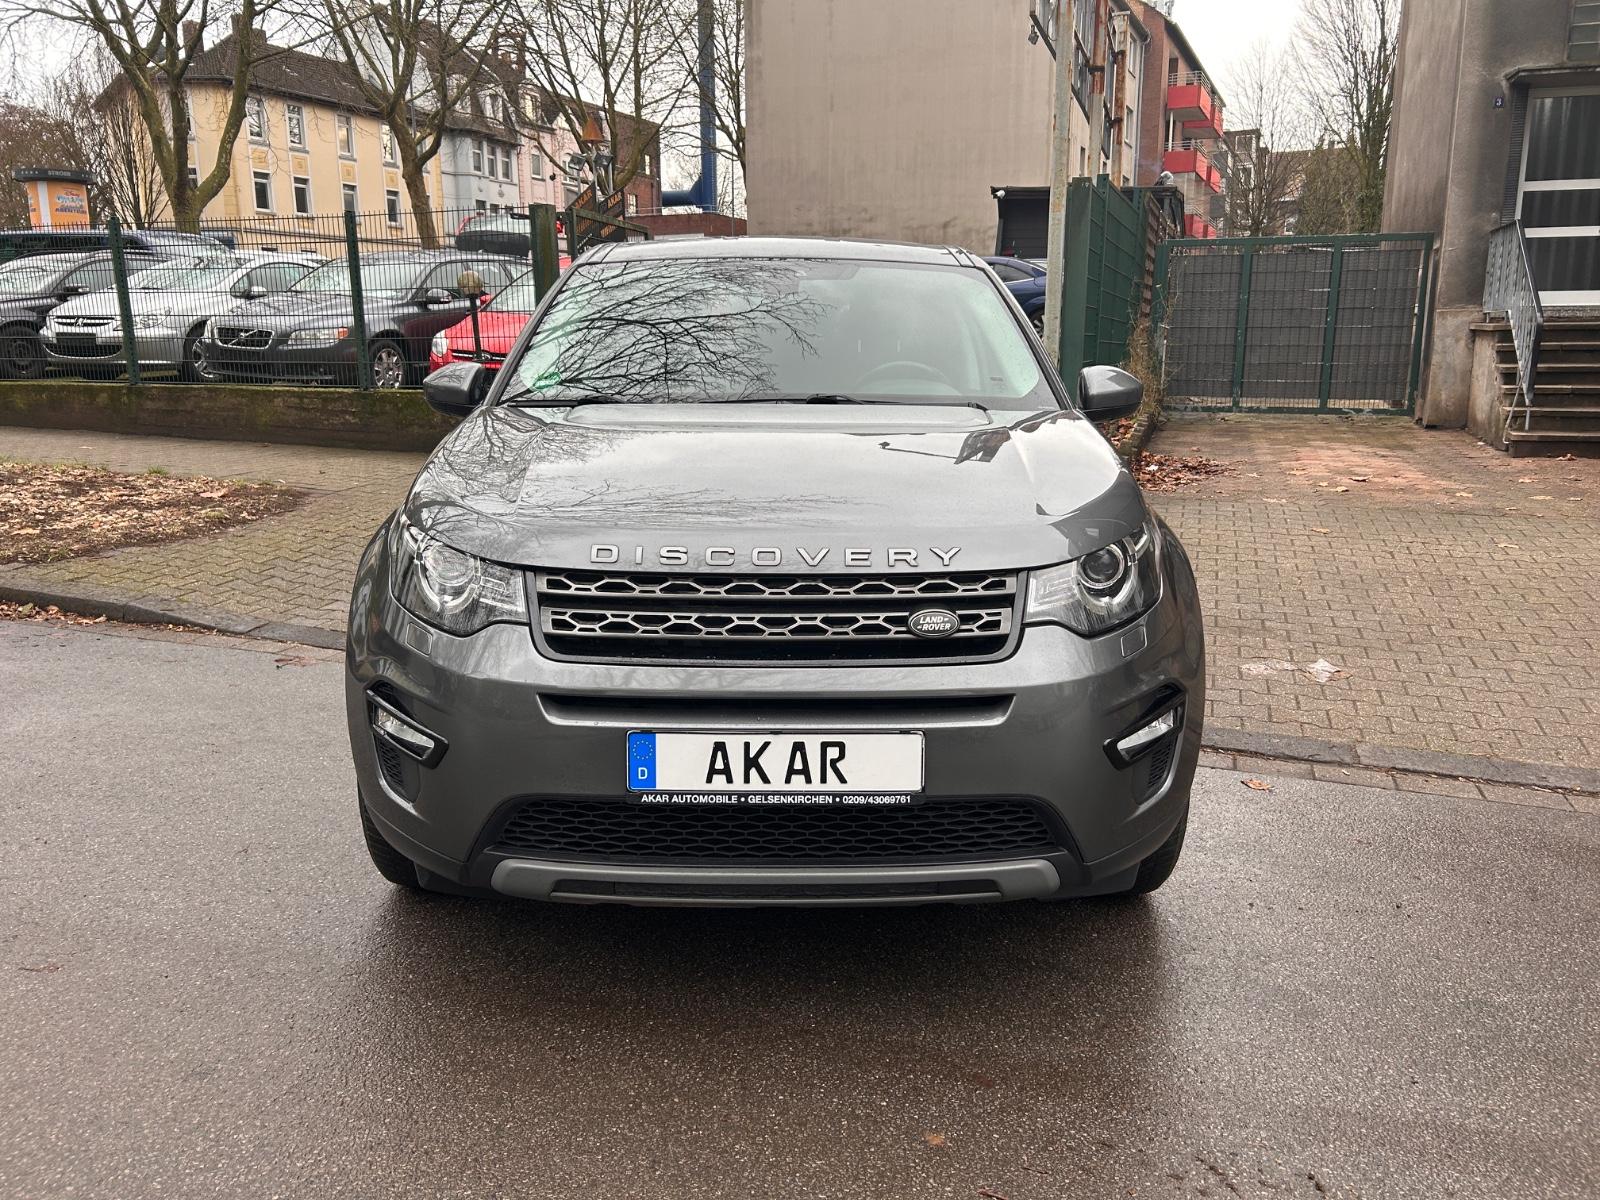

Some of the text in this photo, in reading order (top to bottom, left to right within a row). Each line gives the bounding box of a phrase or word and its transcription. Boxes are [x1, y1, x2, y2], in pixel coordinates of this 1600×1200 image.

[1496, 98, 1502, 106] 3
[575, 189, 592, 209] AKAR
[607, 191, 622, 209] AKAR
[590, 544, 961, 567] DISCOVERY
[919, 616, 943, 624] LAND
[922, 623, 951, 631] ROVER
[705, 741, 848, 784] AKAR
[638, 767, 647, 780] D
[641, 794, 911, 804] AKAR AUTOMOBILE GELSENKIRCHEN 0209/43069761
